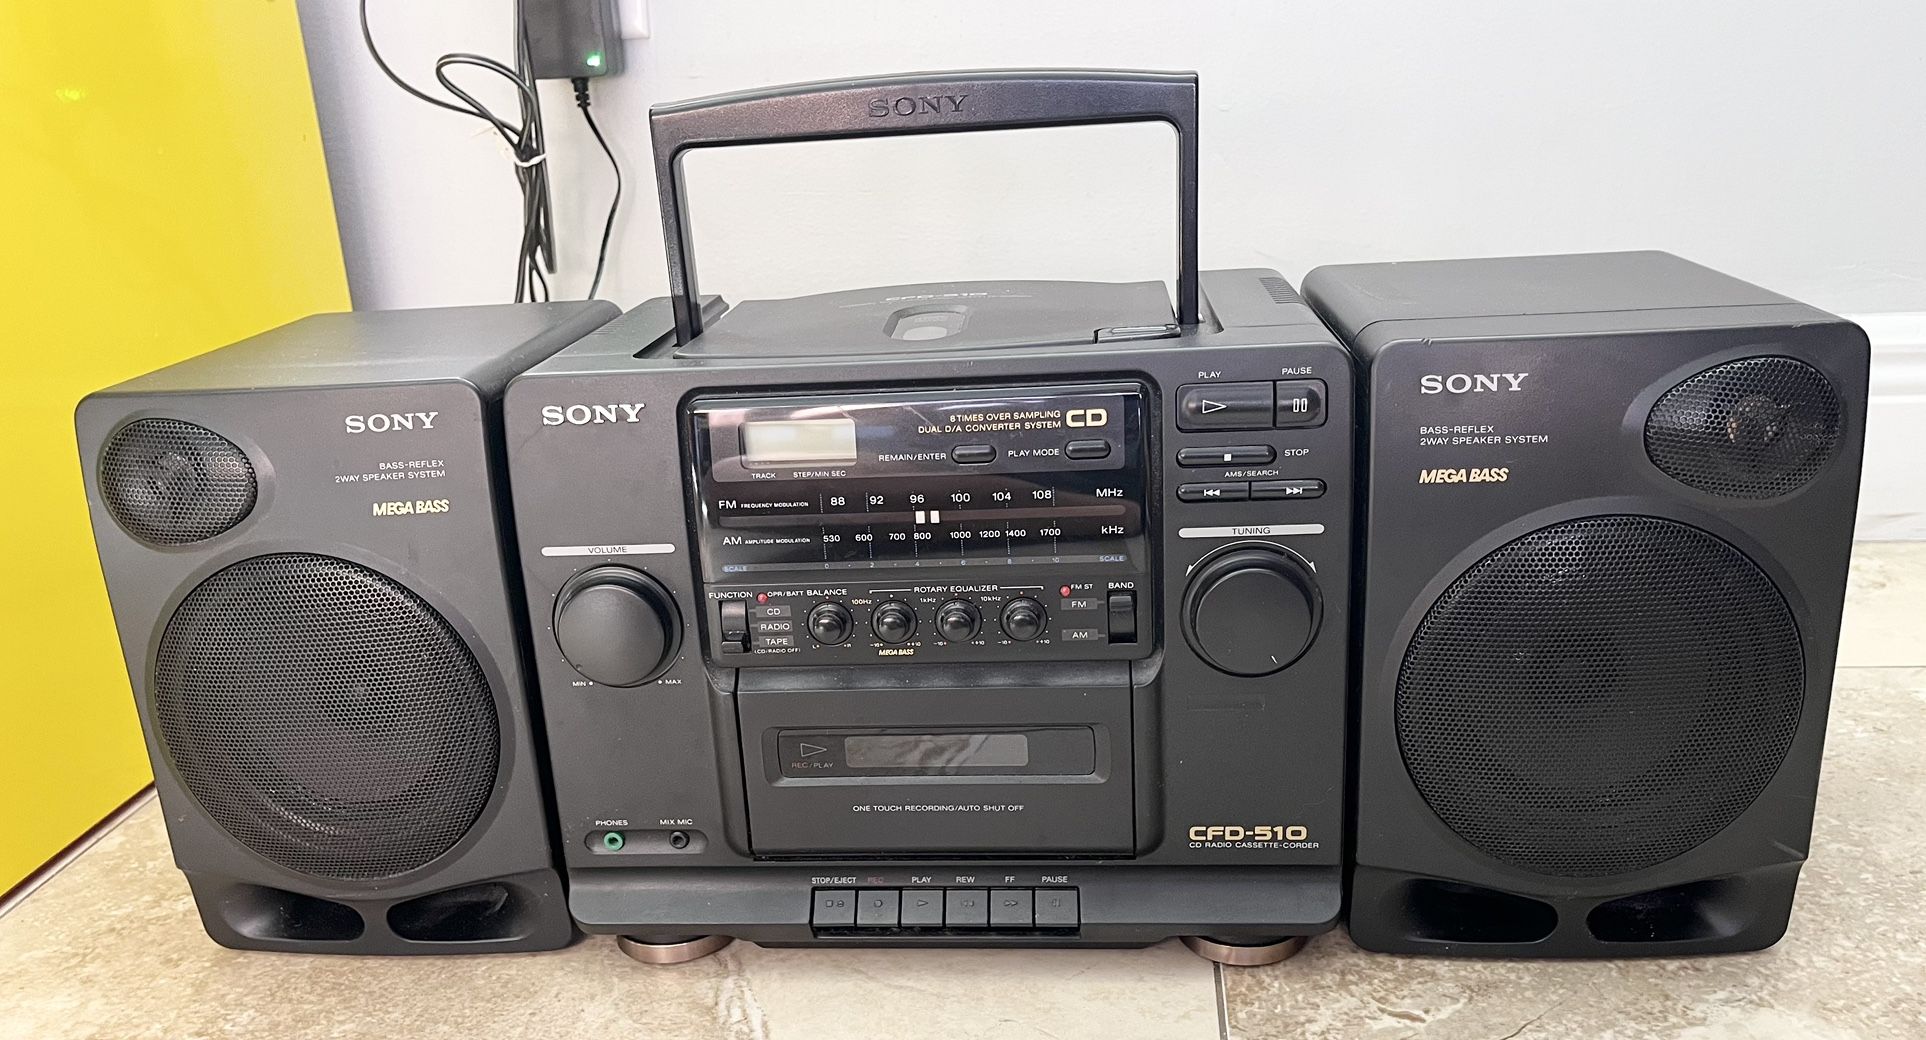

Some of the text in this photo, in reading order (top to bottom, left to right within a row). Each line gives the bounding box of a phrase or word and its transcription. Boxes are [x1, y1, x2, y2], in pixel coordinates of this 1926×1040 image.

[868, 94, 968, 118] SONY
[1197, 370, 1221, 379] PLAY
[1281, 366, 1312, 375] PAUSE
[1420, 372, 1529, 394] SONY
[541, 403, 645, 426] SONY
[987, 412, 1011, 421] OVER
[1013, 410, 1061, 420] SAMPLING
[1065, 408, 1107, 427] CD
[345, 411, 438, 433] SONY
[918, 420, 1061, 434] DUAL D/A CONVERTER SYSTEM
[1420, 425, 1494, 435] BASS-REFLEX
[1420, 435, 1548, 446] 2WAY SPEAKER SYSTEM
[878, 453, 947, 462] REMAIN/ENTER
[1008, 448, 1060, 458] PLAY MODE
[1284, 448, 1310, 457] STOP
[379, 460, 445, 470] BASS-REFLEX
[335, 470, 446, 483] 2WAY SPEAKER SYSTEM
[1224, 469, 1279, 478] AMS/SEARCH
[1419, 467, 1509, 484] MEGA BASS
[830, 490, 1052, 506] 88 92 96 100 104 108
[1096, 488, 1123, 498] MHz
[372, 499, 450, 516] MEGA BASS
[719, 500, 737, 509] FM
[1101, 525, 1124, 535] kHz
[1232, 527, 1271, 535] TUNING
[723, 536, 742, 545] AM
[823, 528, 1061, 543] 530 600 700 800 1000 1200 1400 1700
[588, 546, 628, 554] VOLUME
[950, 585, 998, 593] EQUALIZER
[1108, 581, 1134, 589] BAND
[708, 591, 753, 599] FUNCTION
[806, 588, 848, 596] BALANCE
[766, 608, 780, 616] CD
[760, 623, 790, 631] RADIO
[904, 804, 981, 812] RECORDING/AUTO
[1188, 825, 1308, 841] CFD-510
[811, 876, 857, 884] STOP/EJECT
[1041, 875, 1068, 883] PAUSE
